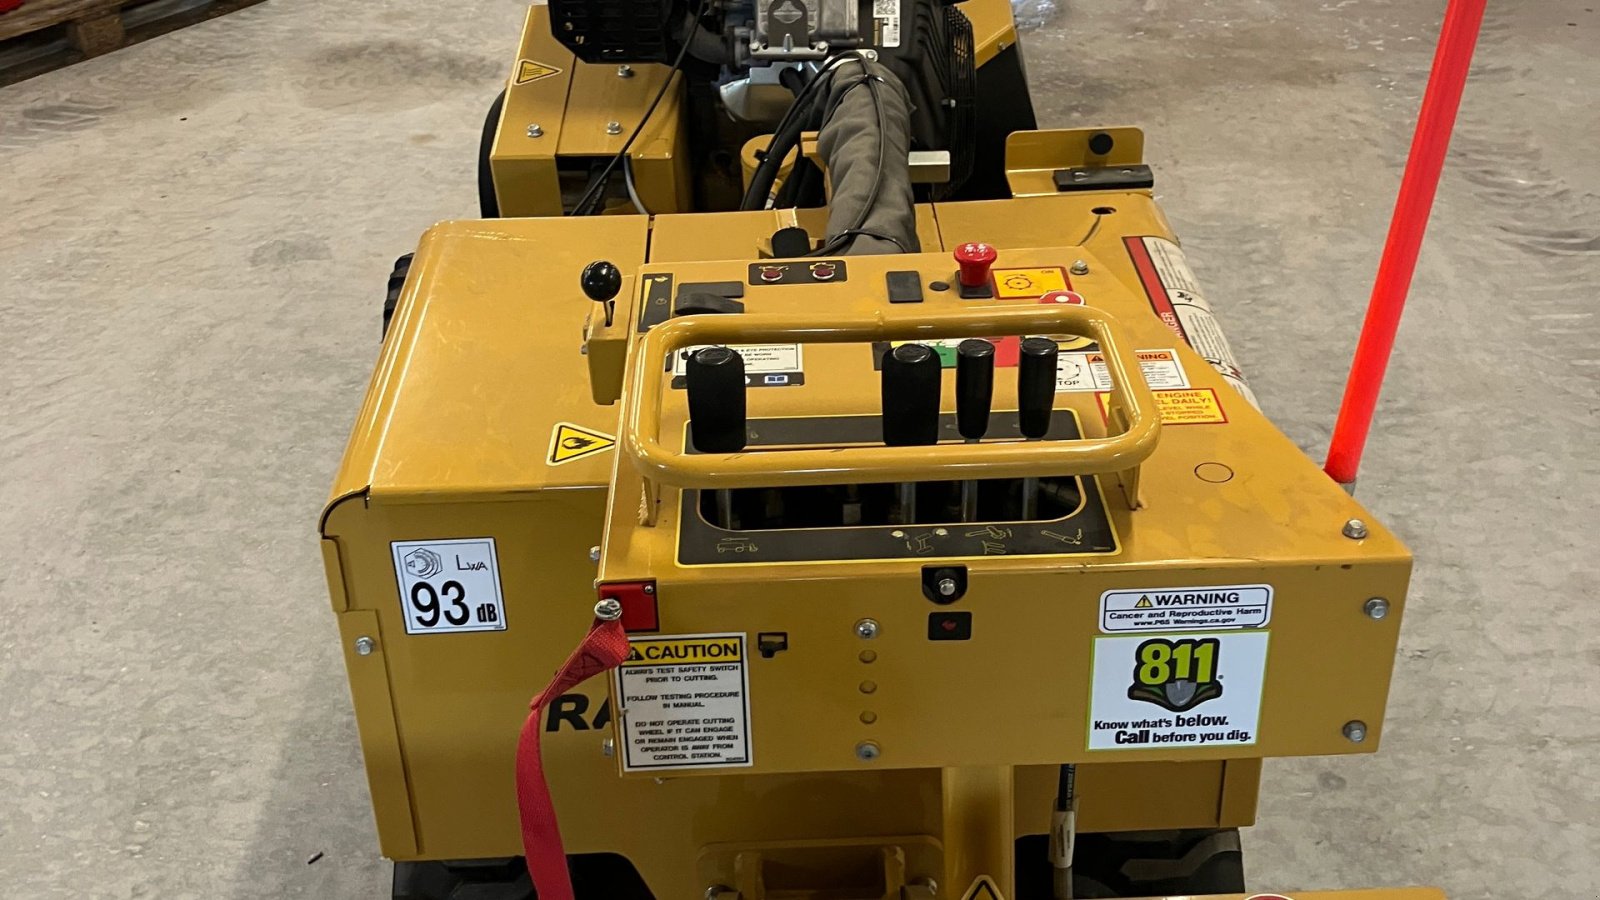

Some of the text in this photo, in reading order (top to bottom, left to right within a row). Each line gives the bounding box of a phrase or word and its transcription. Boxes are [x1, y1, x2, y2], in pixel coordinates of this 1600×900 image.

[411, 580, 497, 627] 93 dB
[1155, 593, 1239, 606] WARNING
[1109, 612, 1144, 620] Cancer
[1148, 610, 1165, 618] and
[1169, 608, 1232, 619] Reproductive
[646, 643, 737, 659] CAUTION
[1140, 643, 1214, 684] 811
[1094, 715, 1229, 730] Know what's below.
[678, 735, 713, 743] ENGAGED
[1115, 730, 1251, 744] Call before you dig.
